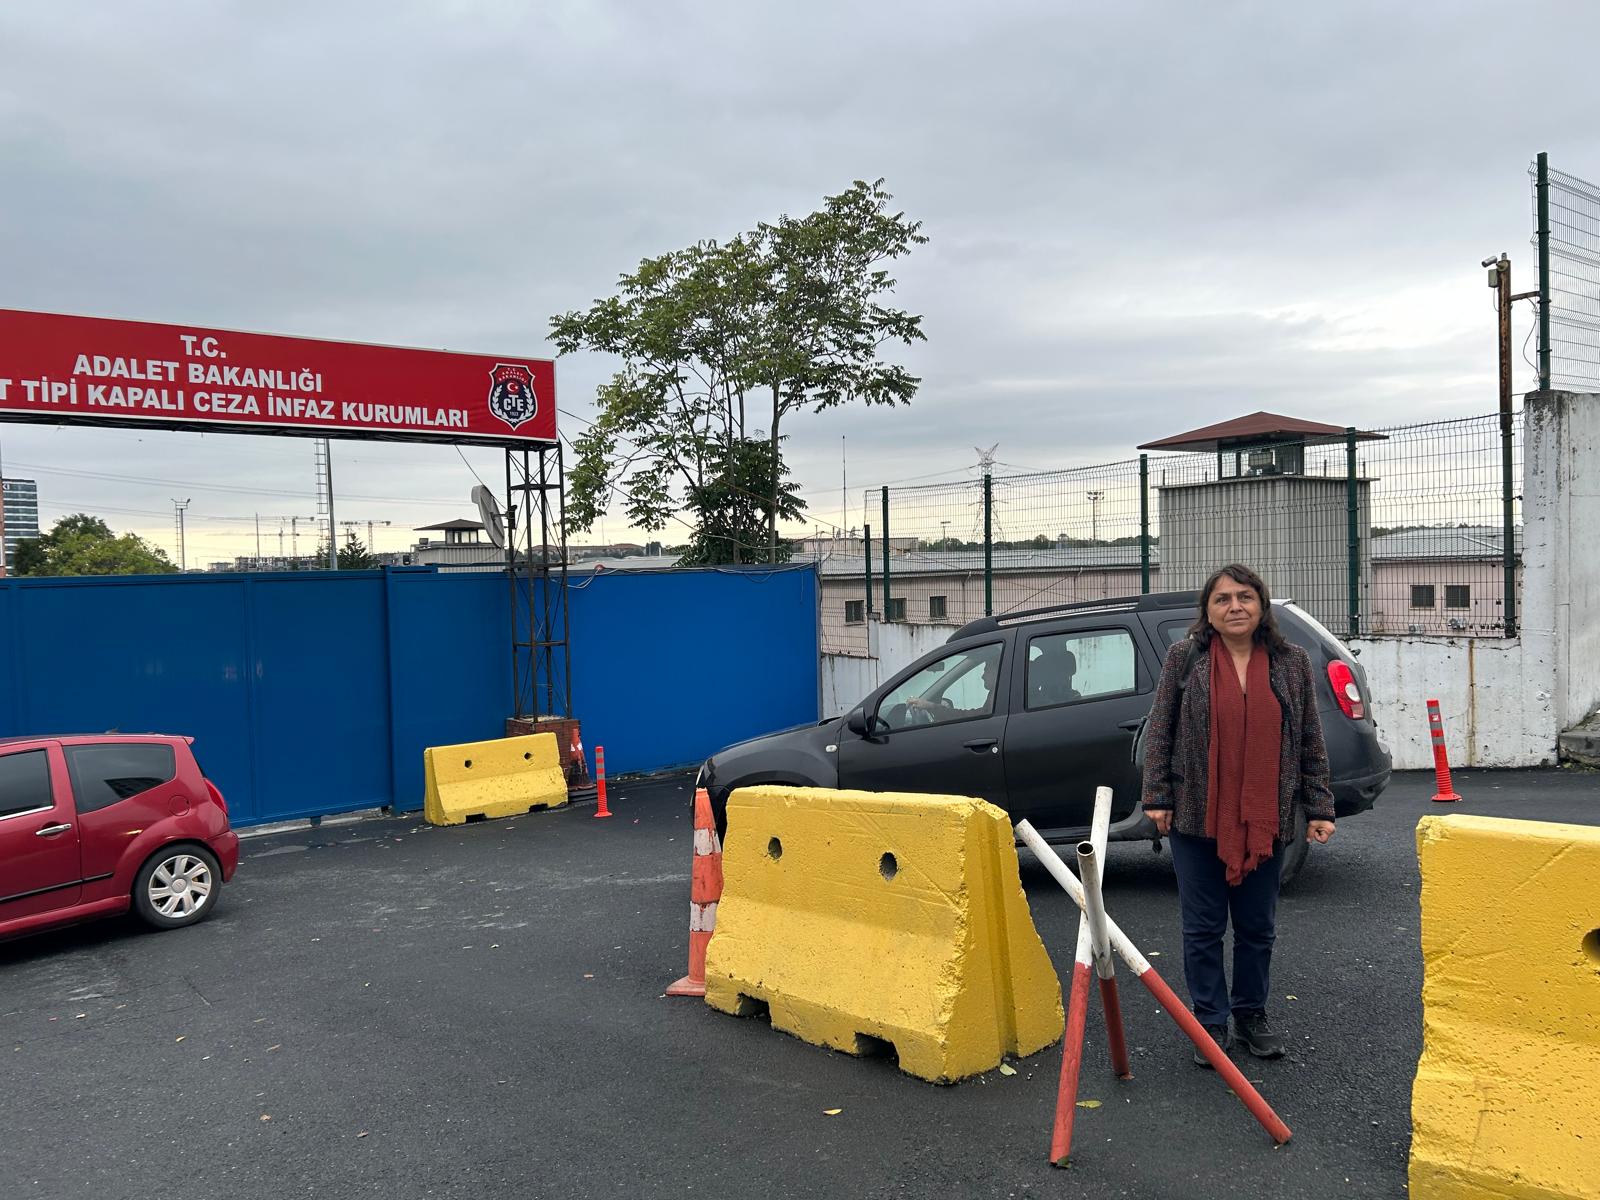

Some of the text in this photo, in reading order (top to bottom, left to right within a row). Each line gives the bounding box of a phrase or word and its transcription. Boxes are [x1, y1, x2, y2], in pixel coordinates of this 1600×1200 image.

[180, 335, 226, 358] T.C.
[73, 355, 321, 393] ADALET BAKANLIĞI
[21, 376, 77, 404] TİPİ
[88, 384, 185, 411] KAPALI
[194, 391, 260, 415] CEZA
[268, 391, 335, 419] İNFAZ
[343, 402, 468, 428] KURUMLARI
[503, 394, 524, 411] CTE
